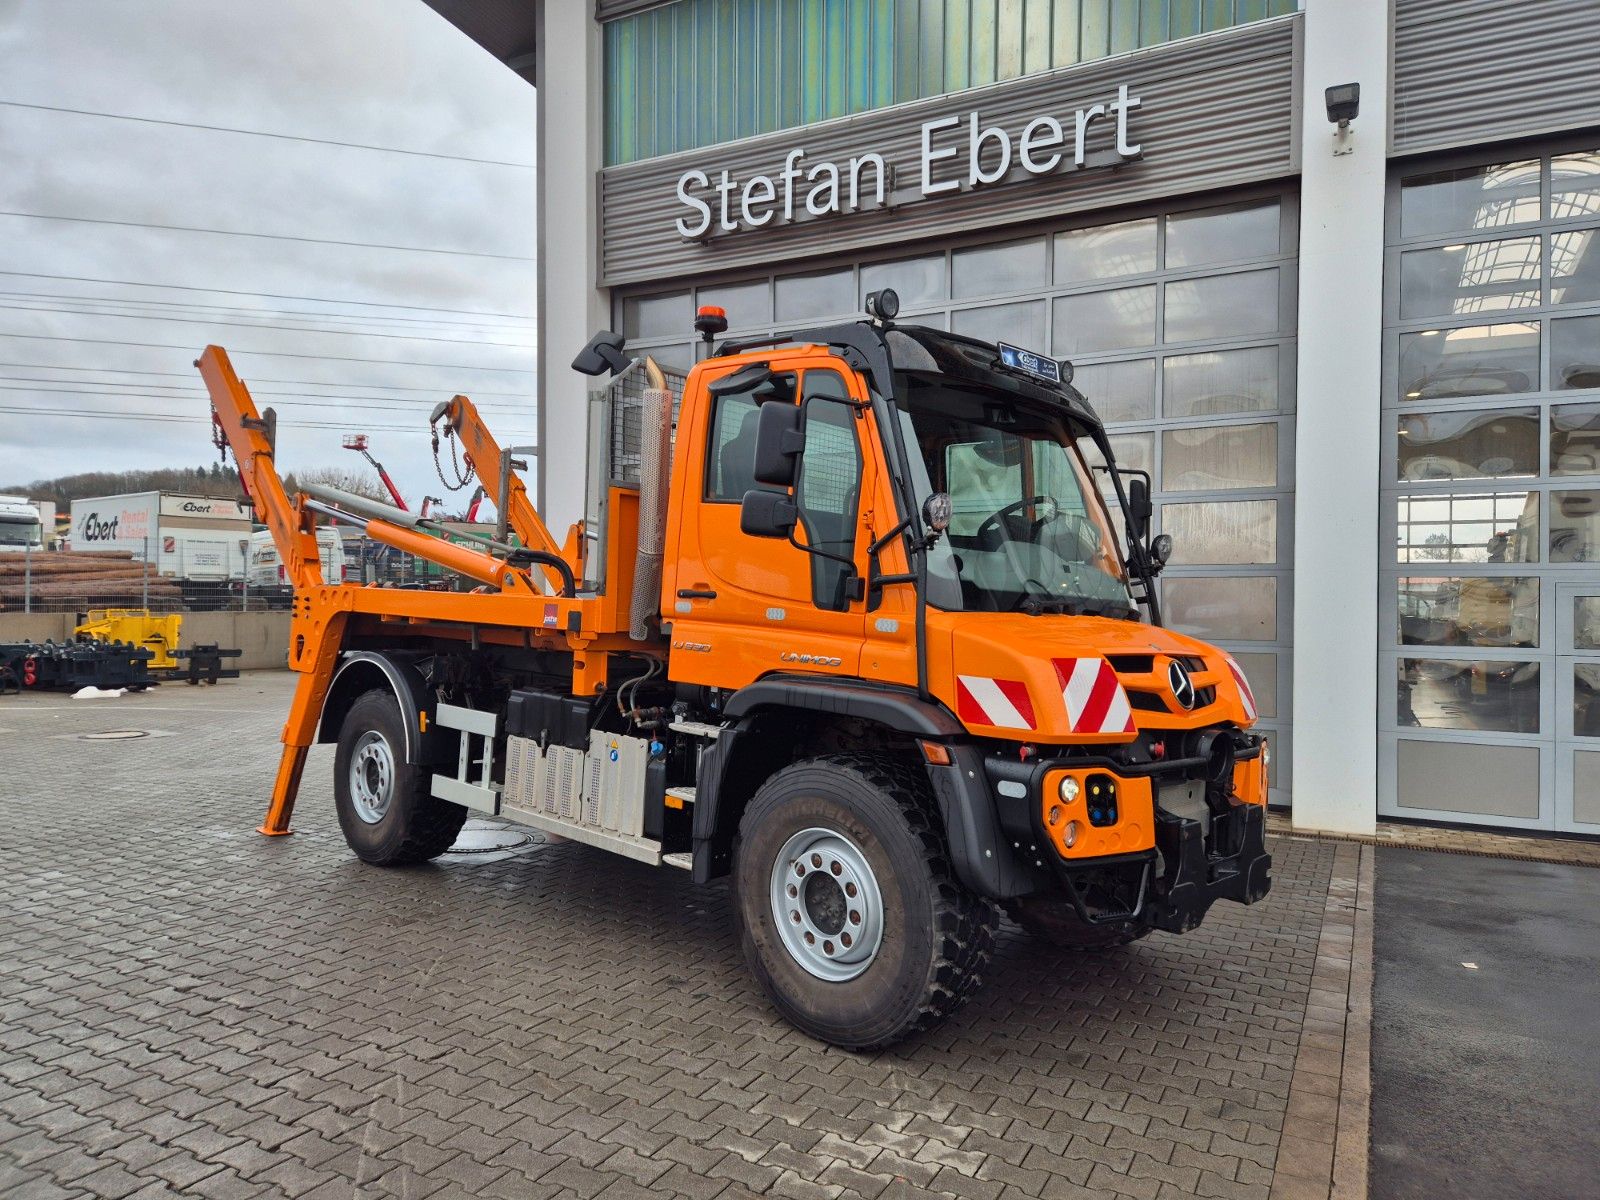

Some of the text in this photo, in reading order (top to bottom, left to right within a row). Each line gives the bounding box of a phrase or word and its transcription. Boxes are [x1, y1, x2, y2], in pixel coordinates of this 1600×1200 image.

[675, 84, 1143, 238] Stefan Ebert
[183, 501, 211, 513] Ebert
[85, 512, 118, 541] Ebert
[780, 652, 842, 667] UNIMOG
